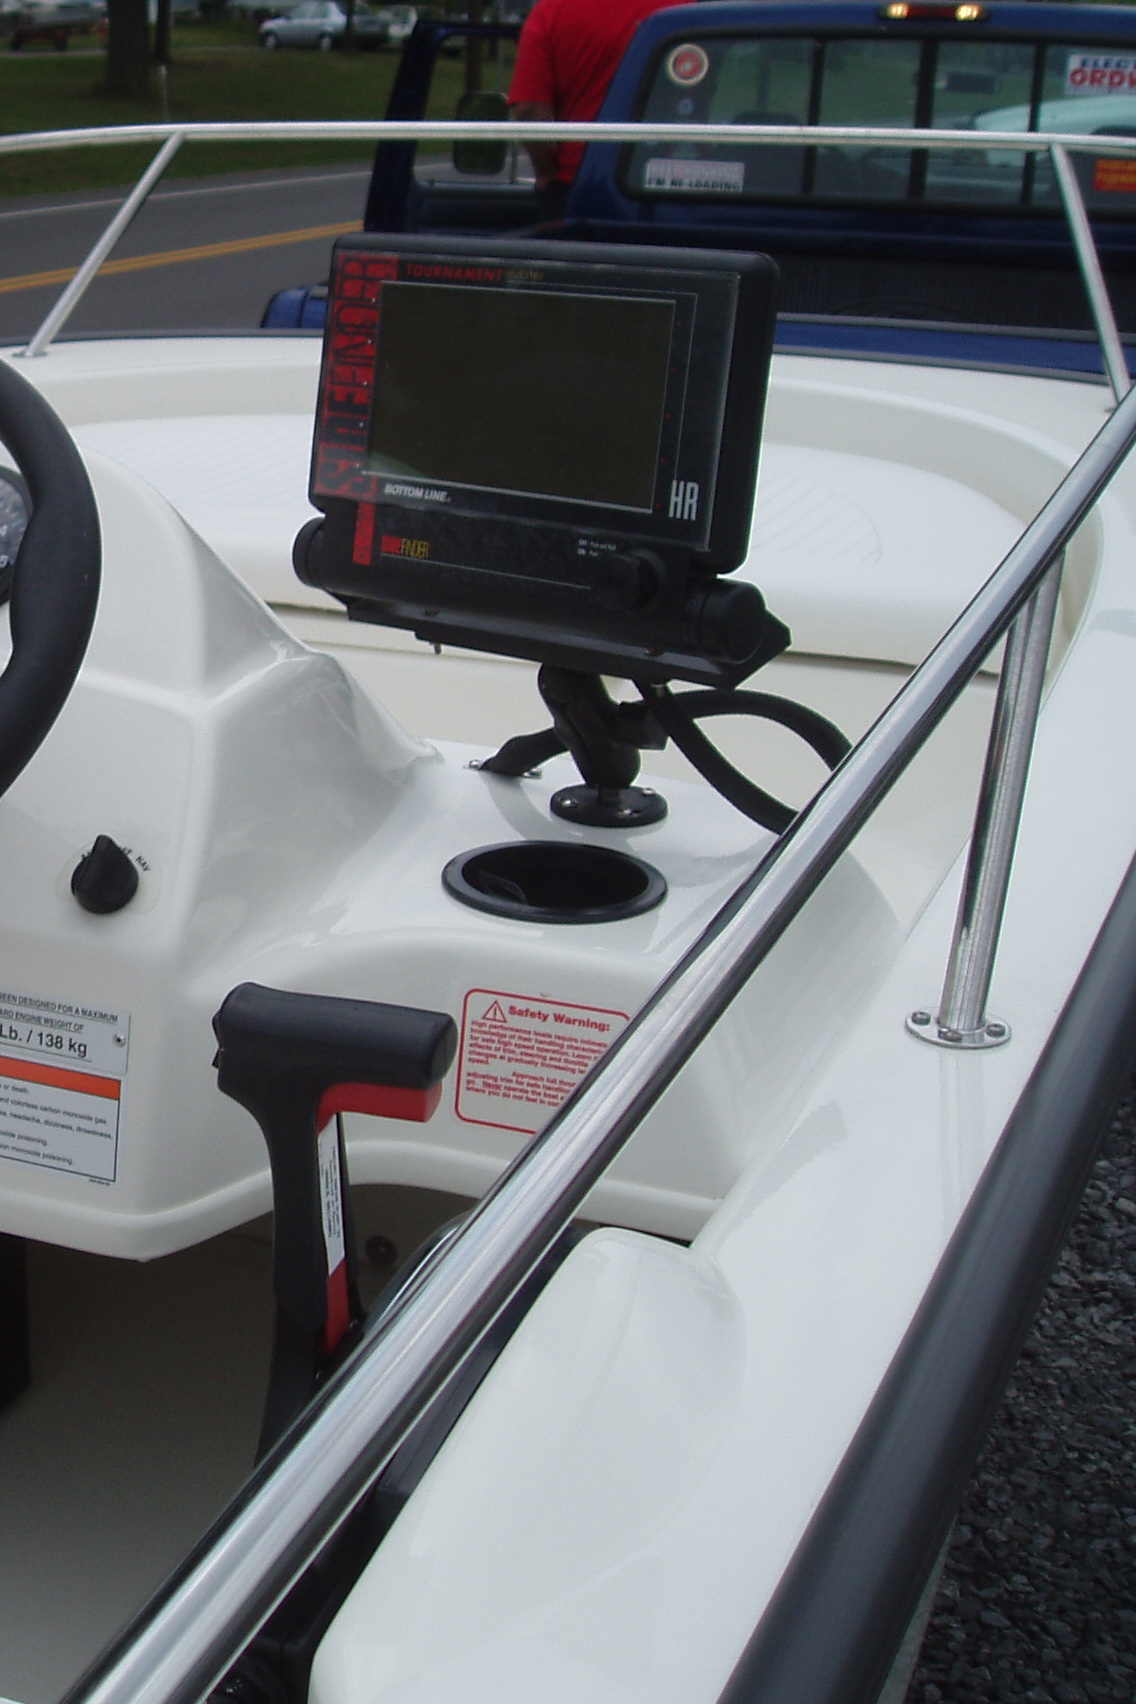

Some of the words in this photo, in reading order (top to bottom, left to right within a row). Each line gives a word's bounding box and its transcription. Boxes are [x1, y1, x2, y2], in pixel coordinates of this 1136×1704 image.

[405, 264, 503, 282] TOURNAMENT
[384, 483, 424, 499] BOTTOM
[668, 480, 699, 521] HR
[15, 1010, 42, 1025] ENGINE
[43, 1016, 70, 1030] WEIGHT
[18, 996, 56, 1010] DESIGNED
[57, 1003, 72, 1013] FOR
[81, 1008, 117, 1022] MAXIMUM
[508, 1004, 550, 1023] Safety
[553, 1011, 611, 1033] Warning:
[0, 1023, 22, 1041] Lb.
[26, 1028, 32, 1043] /
[37, 1030, 63, 1049] 138
[68, 1037, 87, 1058] kg
